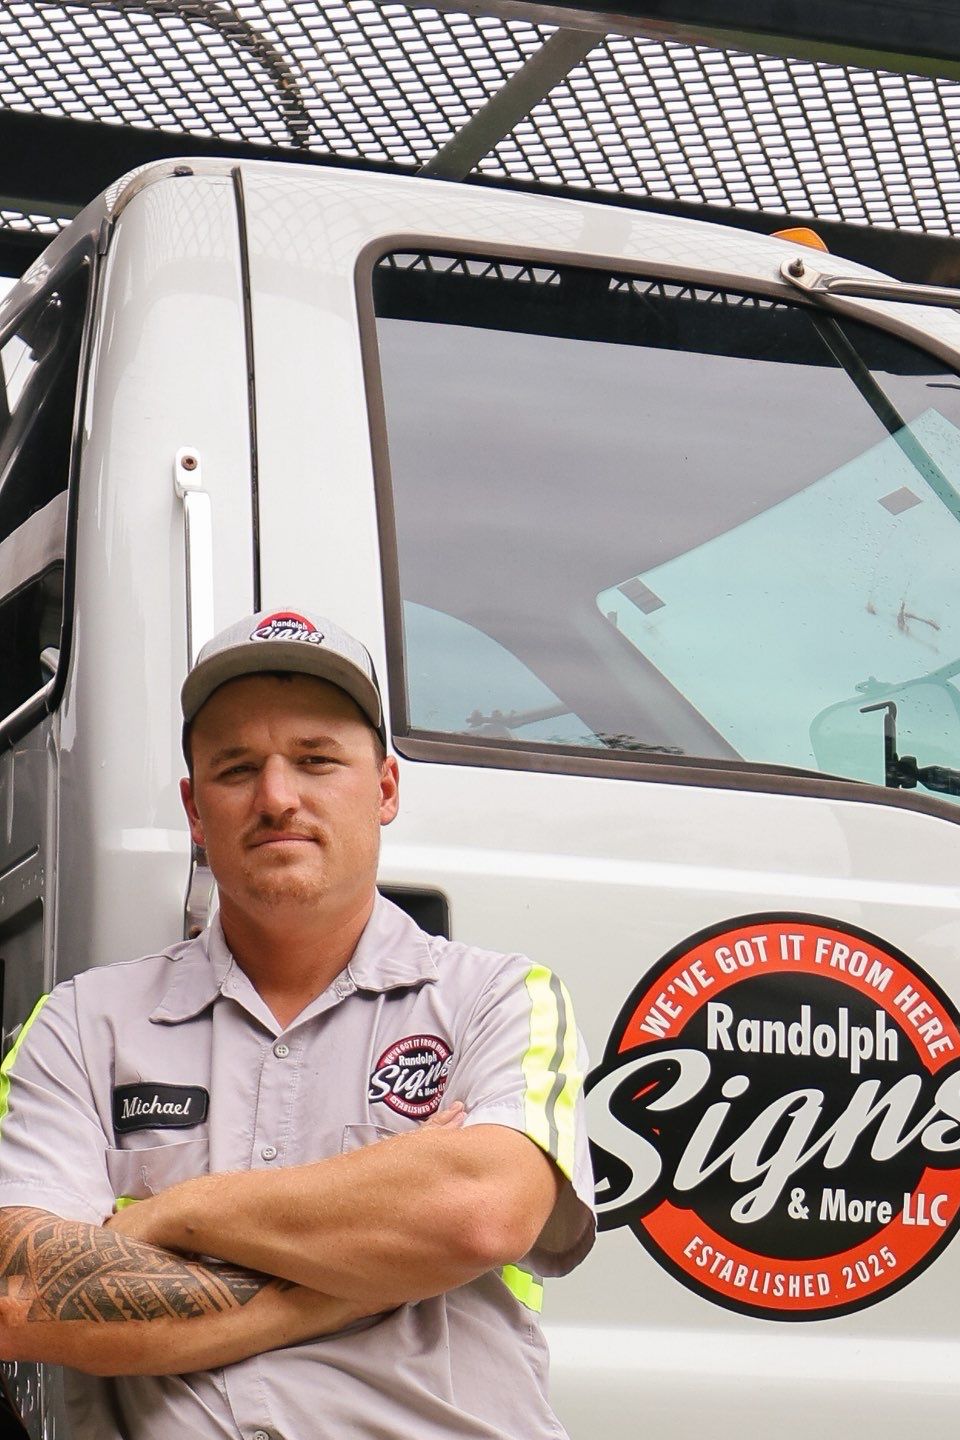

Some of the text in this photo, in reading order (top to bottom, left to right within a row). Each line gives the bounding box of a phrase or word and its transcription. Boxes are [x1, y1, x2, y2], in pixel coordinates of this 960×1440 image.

[271, 620, 308, 630] Randolph
[639, 934, 955, 1060] WE'VE GOT IT FROM HERE
[707, 1001, 899, 1074] Randolph
[399, 1051, 438, 1066] Randolph
[121, 1095, 192, 1119] Michael
[787, 1187, 948, 1228] & More LLC
[683, 1236, 898, 1298] ESTABLISHED 2025
